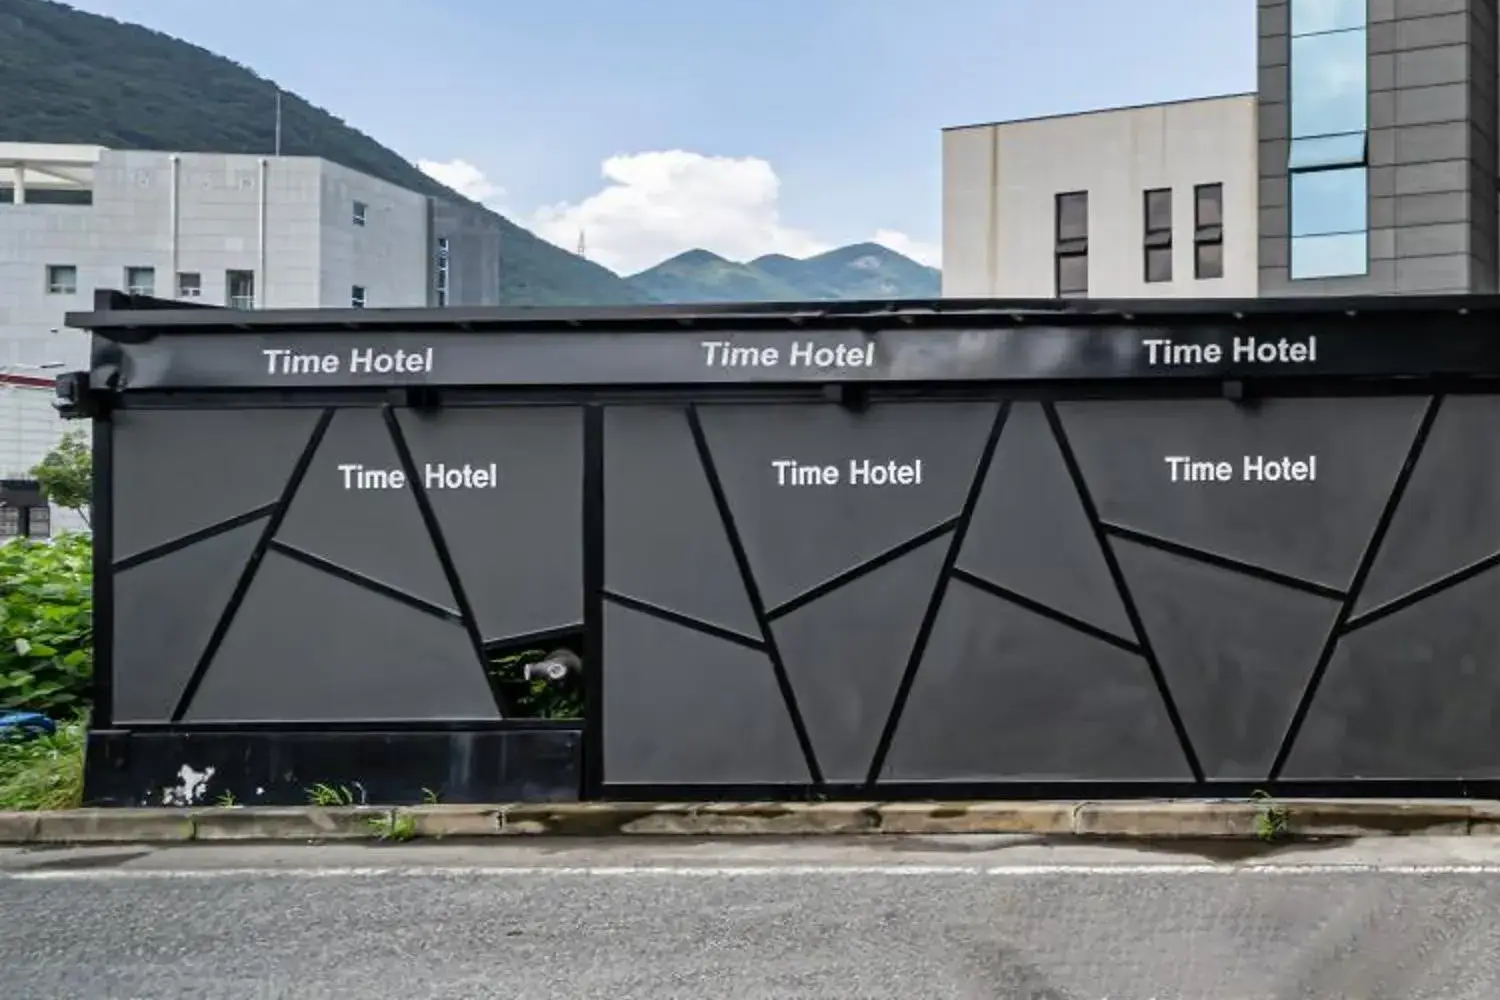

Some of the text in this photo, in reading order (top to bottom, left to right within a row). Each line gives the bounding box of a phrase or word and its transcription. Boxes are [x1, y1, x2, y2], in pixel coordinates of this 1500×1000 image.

[263, 347, 434, 374] Time Hotel
[702, 342, 875, 367] Time Hotel
[1142, 336, 1316, 365] Time Hotel
[337, 463, 497, 490] Time Hotel
[771, 459, 922, 486] Time Hotel
[1164, 455, 1317, 482] Time Hotel
